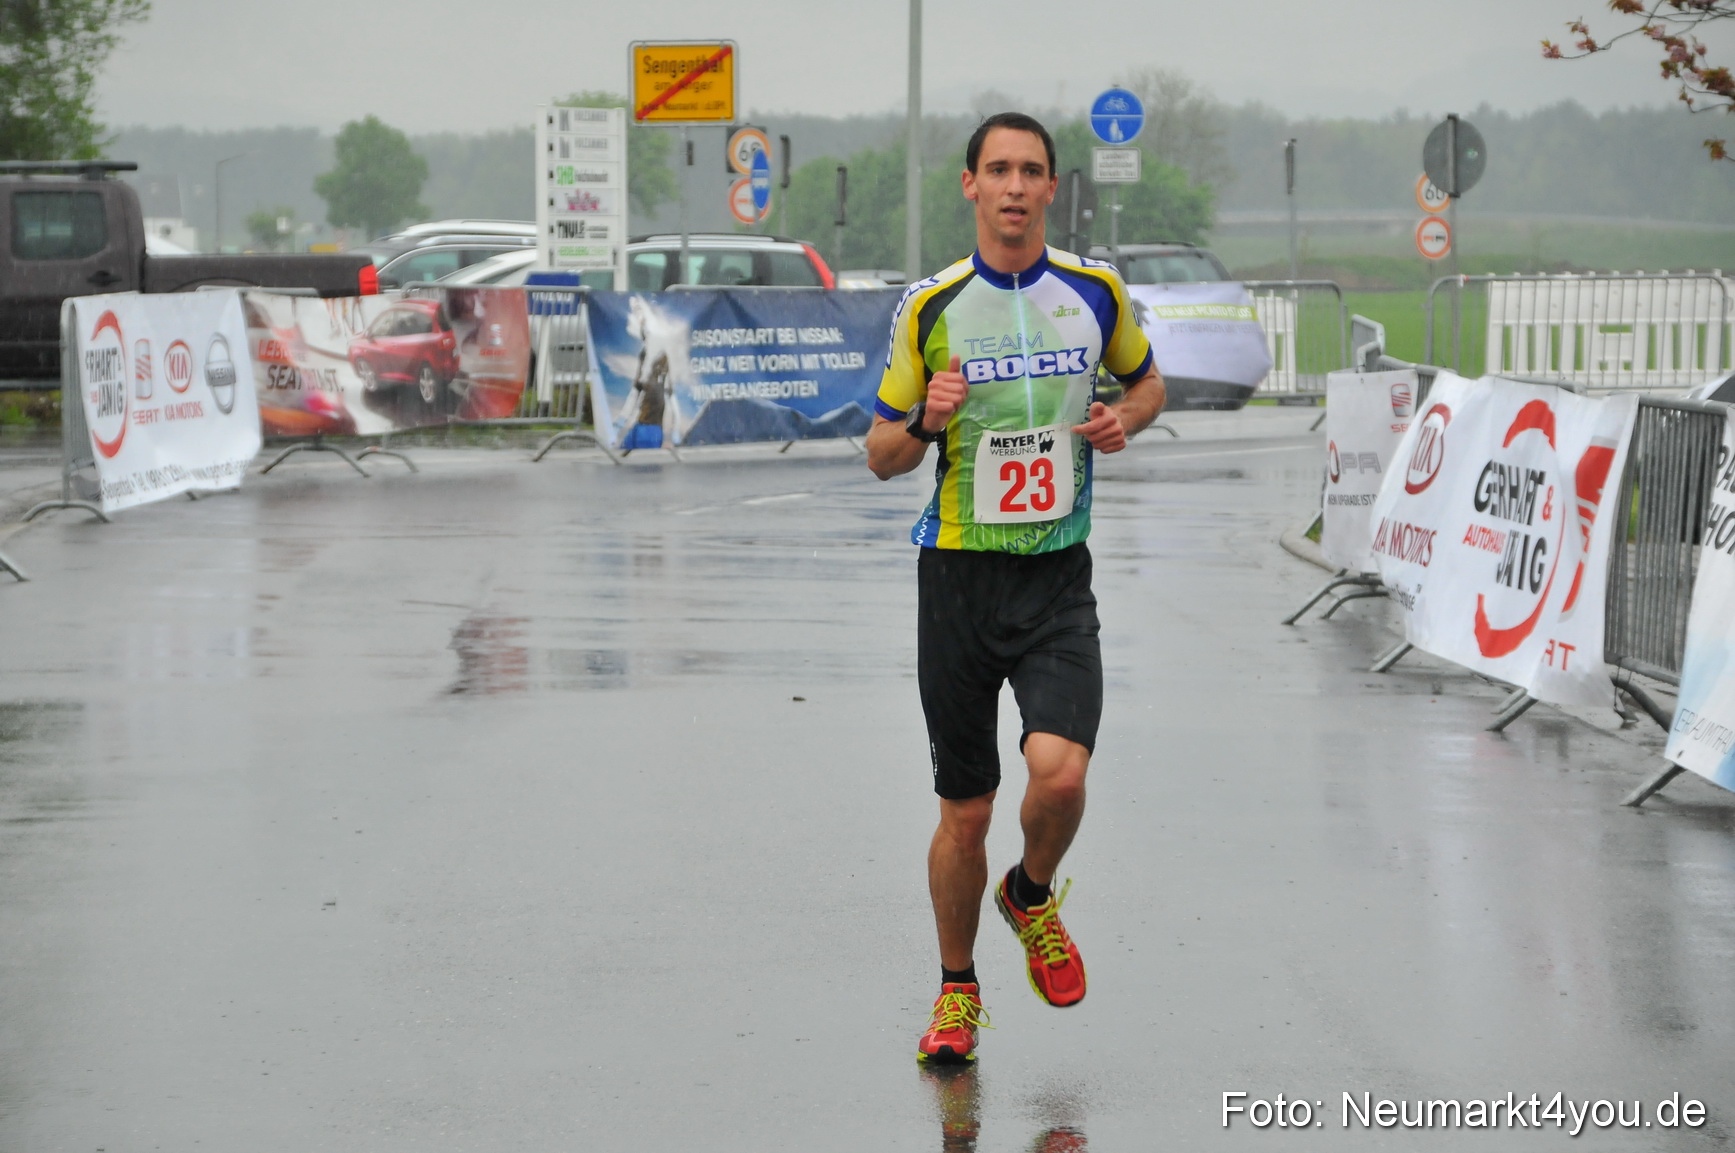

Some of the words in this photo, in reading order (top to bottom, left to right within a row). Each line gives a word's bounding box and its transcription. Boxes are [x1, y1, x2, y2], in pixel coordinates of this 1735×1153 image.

[692, 328, 775, 346] SAISONSTART
[776, 327, 797, 345] BEI
[798, 327, 844, 344] NISSAN:
[964, 331, 1044, 355] TEAM
[168, 352, 188, 380] KIA
[690, 356, 726, 373] GANZ
[728, 355, 756, 372] WEIT
[757, 353, 799, 371] VORN
[801, 354, 821, 370] MIT
[821, 352, 866, 369] TOLLEN
[962, 347, 1089, 385] BOCK
[692, 380, 818, 400] WINTERANGEBOTEN
[132, 408, 159, 425] SEAT
[990, 434, 1035, 448] MEYER
[990, 445, 1037, 456] WERBUNG
[1411, 425, 1439, 474] KIA
[999, 457, 1056, 513] 23
[1717, 445, 1735, 493] PA
[1542, 485, 1554, 521] &
[1388, 520, 1438, 568] MOTORS
[1705, 503, 1735, 555] HO
[1496, 530, 1548, 595] JAIG
